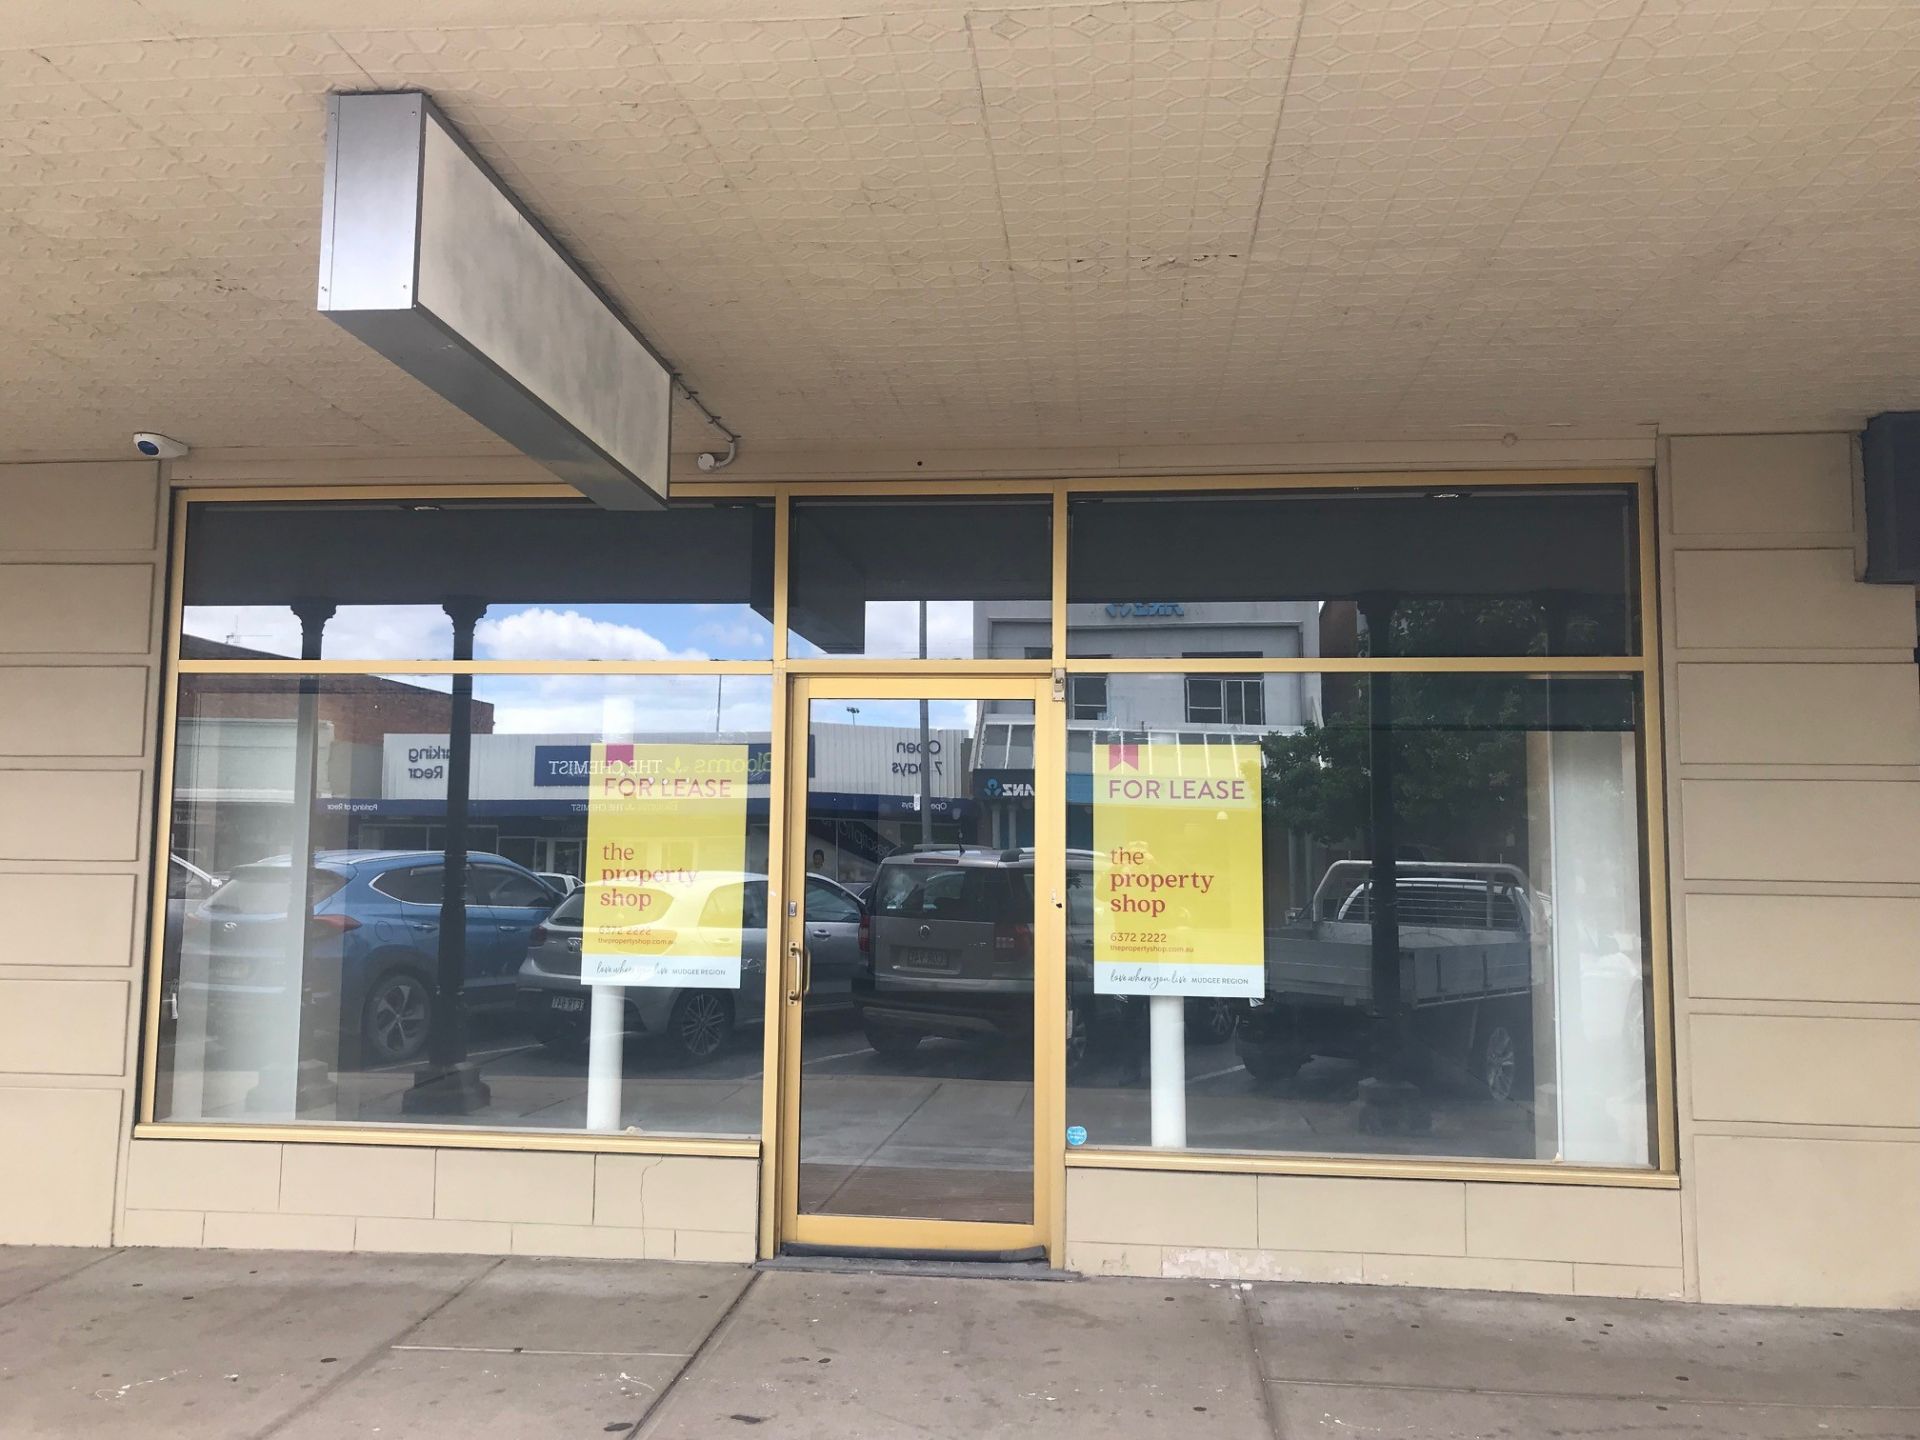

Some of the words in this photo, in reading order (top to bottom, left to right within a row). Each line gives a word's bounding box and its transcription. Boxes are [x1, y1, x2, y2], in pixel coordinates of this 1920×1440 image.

[604, 778, 652, 796] FOR
[662, 778, 732, 797] LEASE
[1109, 779, 1160, 799] FOR
[1169, 780, 1245, 799] LEASE
[603, 842, 634, 861] the
[1111, 847, 1145, 865] the
[602, 868, 699, 888] property
[1110, 872, 1215, 894] property
[600, 888, 652, 911] shop
[1110, 894, 1166, 917] shop
[1110, 932, 1137, 942] 6372
[1140, 933, 1167, 943] 2222
[672, 968, 700, 976] MUDGEE
[700, 968, 726, 976] REGION
[1110, 969, 1127, 982] love
[1171, 970, 1187, 983] live
